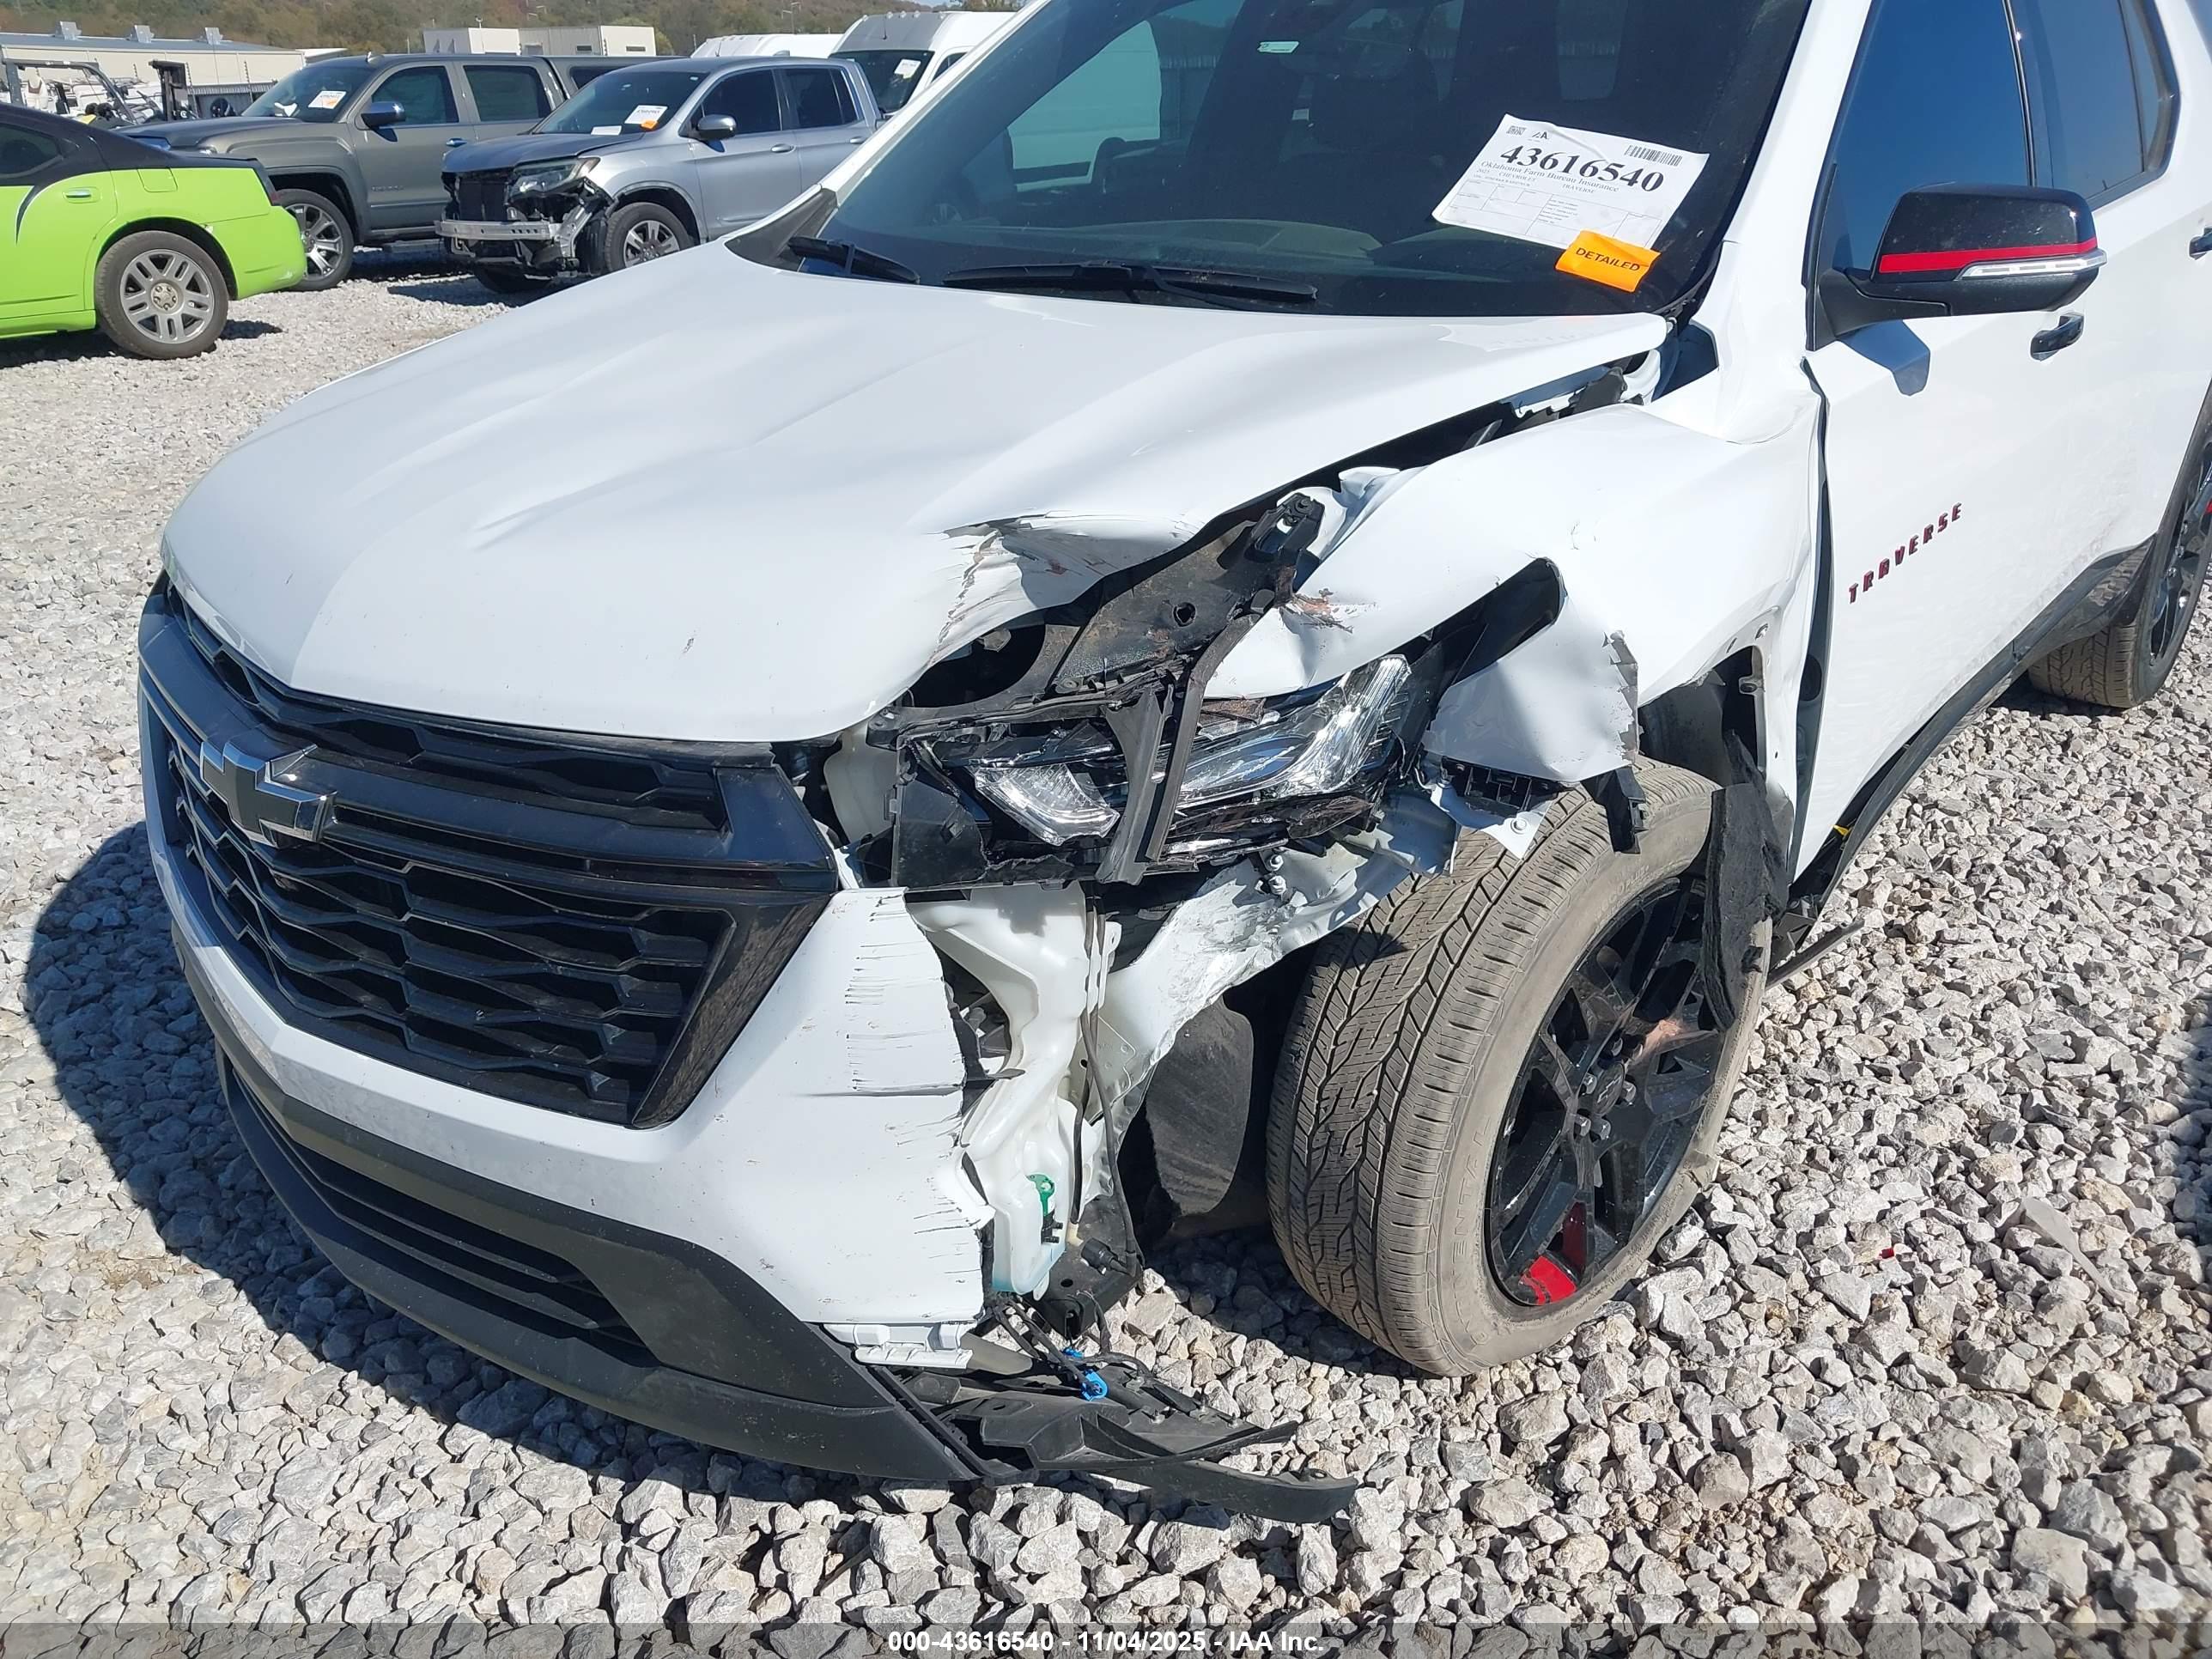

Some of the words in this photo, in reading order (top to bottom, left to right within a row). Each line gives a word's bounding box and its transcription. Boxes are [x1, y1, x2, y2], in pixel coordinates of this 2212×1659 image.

[1481, 161, 1522, 173] Oklahoma
[1524, 167, 1545, 179] Farm
[1547, 172, 1577, 185] Bureau
[1578, 178, 1620, 193] Insurance
[1500, 144, 1664, 192] 43616540
[1576, 246, 1641, 272] DETAILED
[1849, 502, 1962, 605] TRAVERSE
